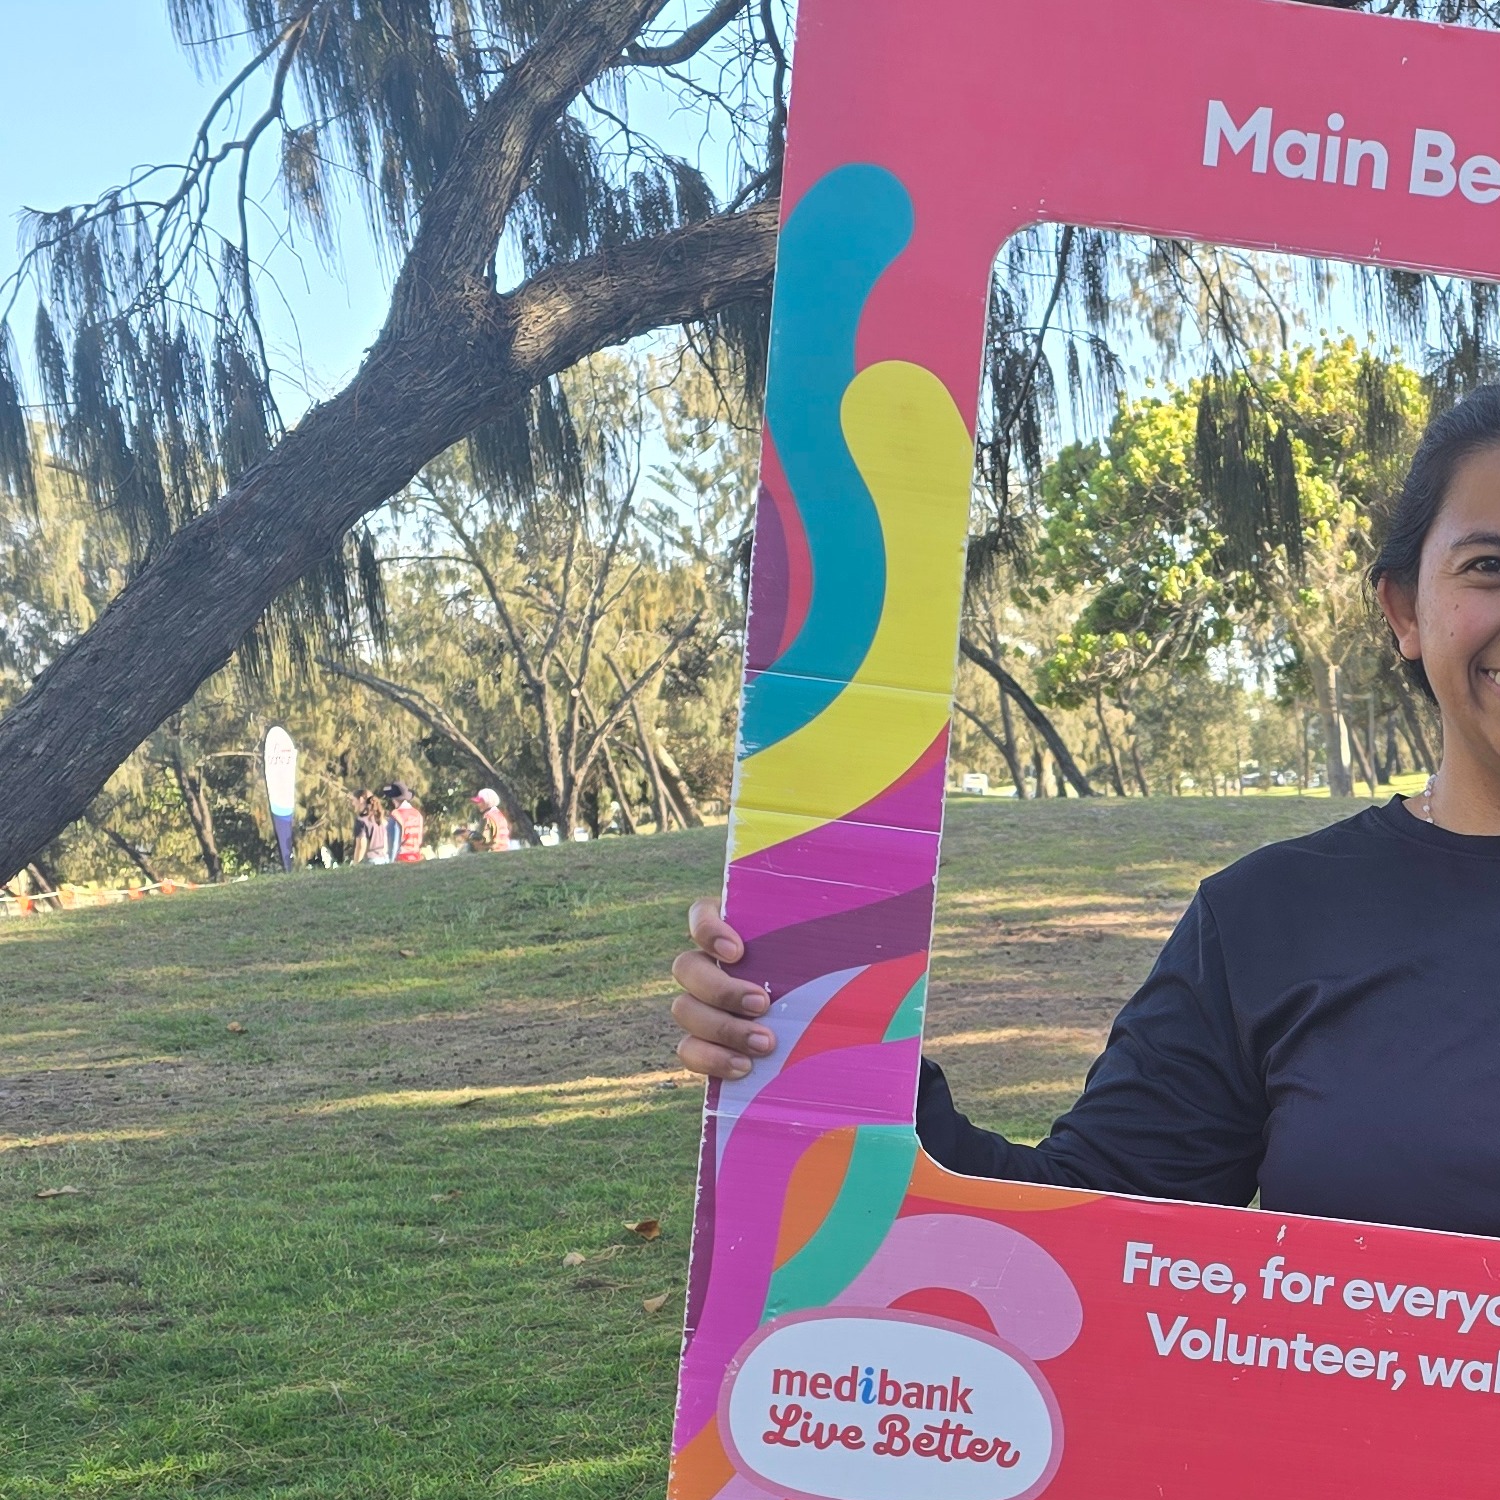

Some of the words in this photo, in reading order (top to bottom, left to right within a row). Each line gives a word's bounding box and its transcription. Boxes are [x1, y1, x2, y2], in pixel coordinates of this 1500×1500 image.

[1202, 98, 1389, 190] Main
[1122, 1240, 1247, 1304] Free,
[1259, 1255, 1343, 1306] for
[1146, 1311, 1406, 1390] Volunteer,
[771, 1365, 974, 1414] medibank
[762, 1403, 865, 1450] Live
[872, 1413, 1021, 1468] Better
